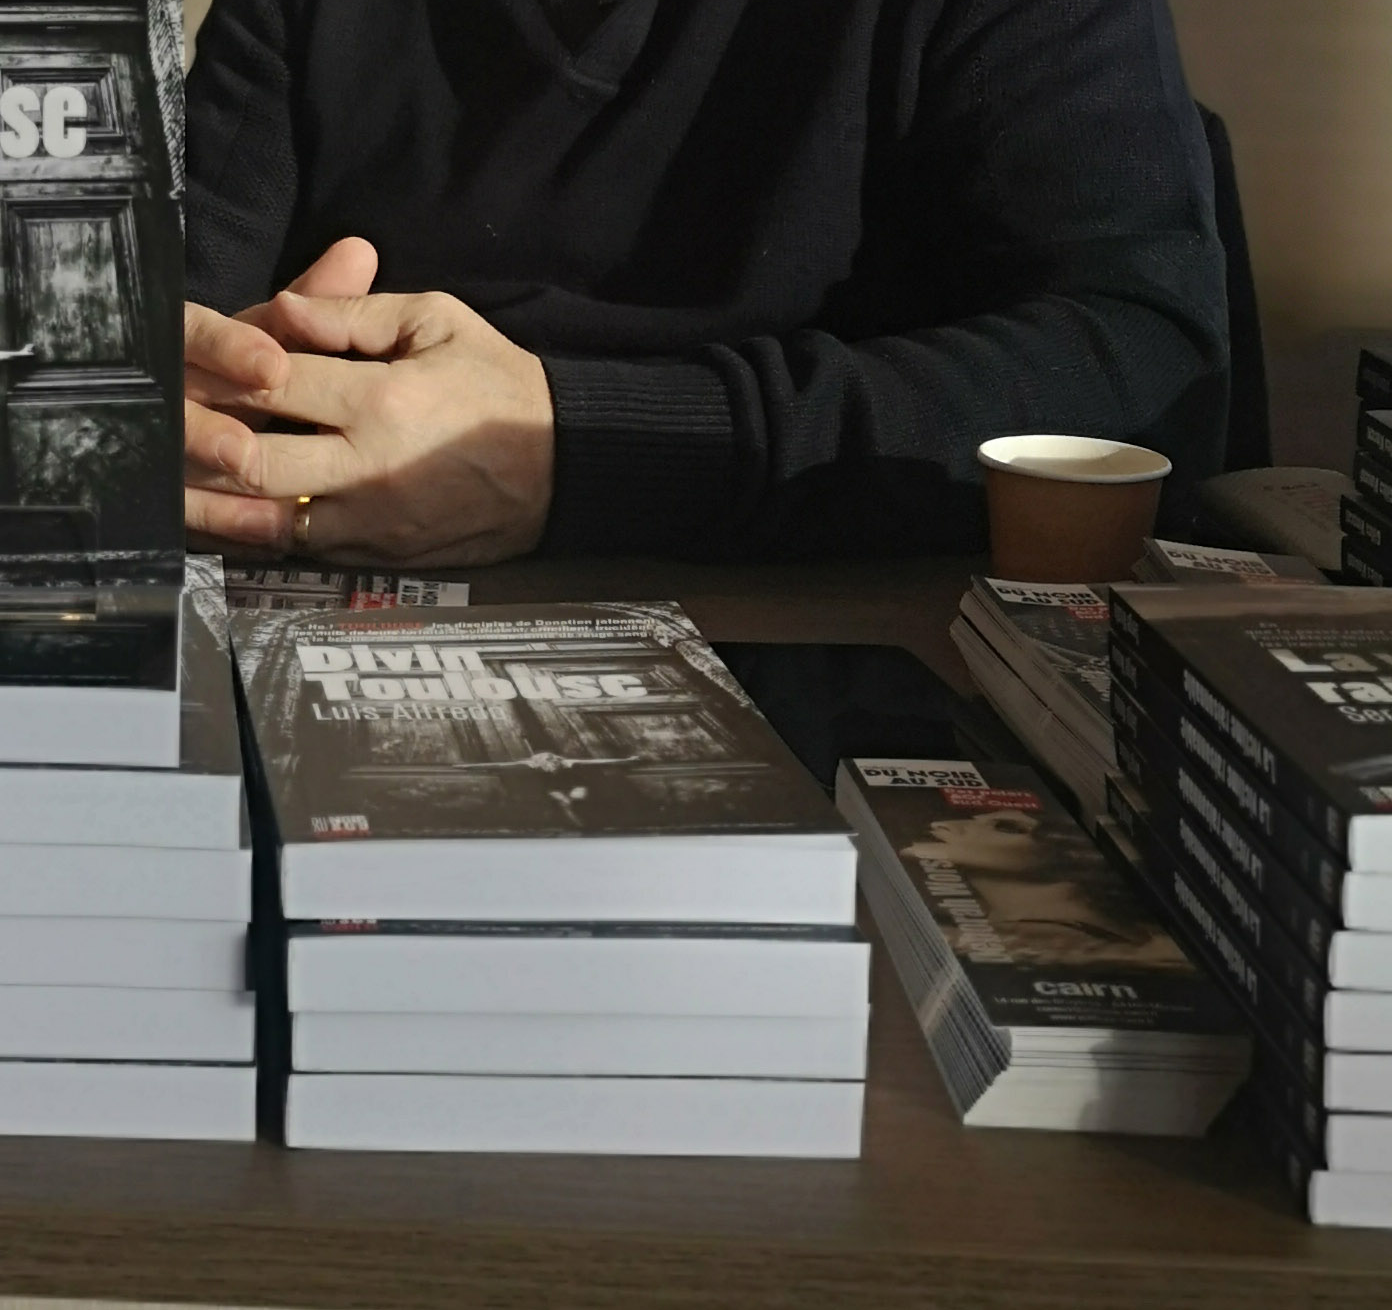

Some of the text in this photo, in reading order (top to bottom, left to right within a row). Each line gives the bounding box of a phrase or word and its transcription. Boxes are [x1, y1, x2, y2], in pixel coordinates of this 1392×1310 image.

[297, 643, 486, 672] Divin
[1268, 649, 1378, 672] La
[304, 669, 648, 701] Toulouse
[312, 702, 507, 721] Luis Alfredo
[864, 769, 978, 780] DU NOIR
[890, 777, 984, 788] AU SUD
[1033, 981, 1139, 999] cairn
